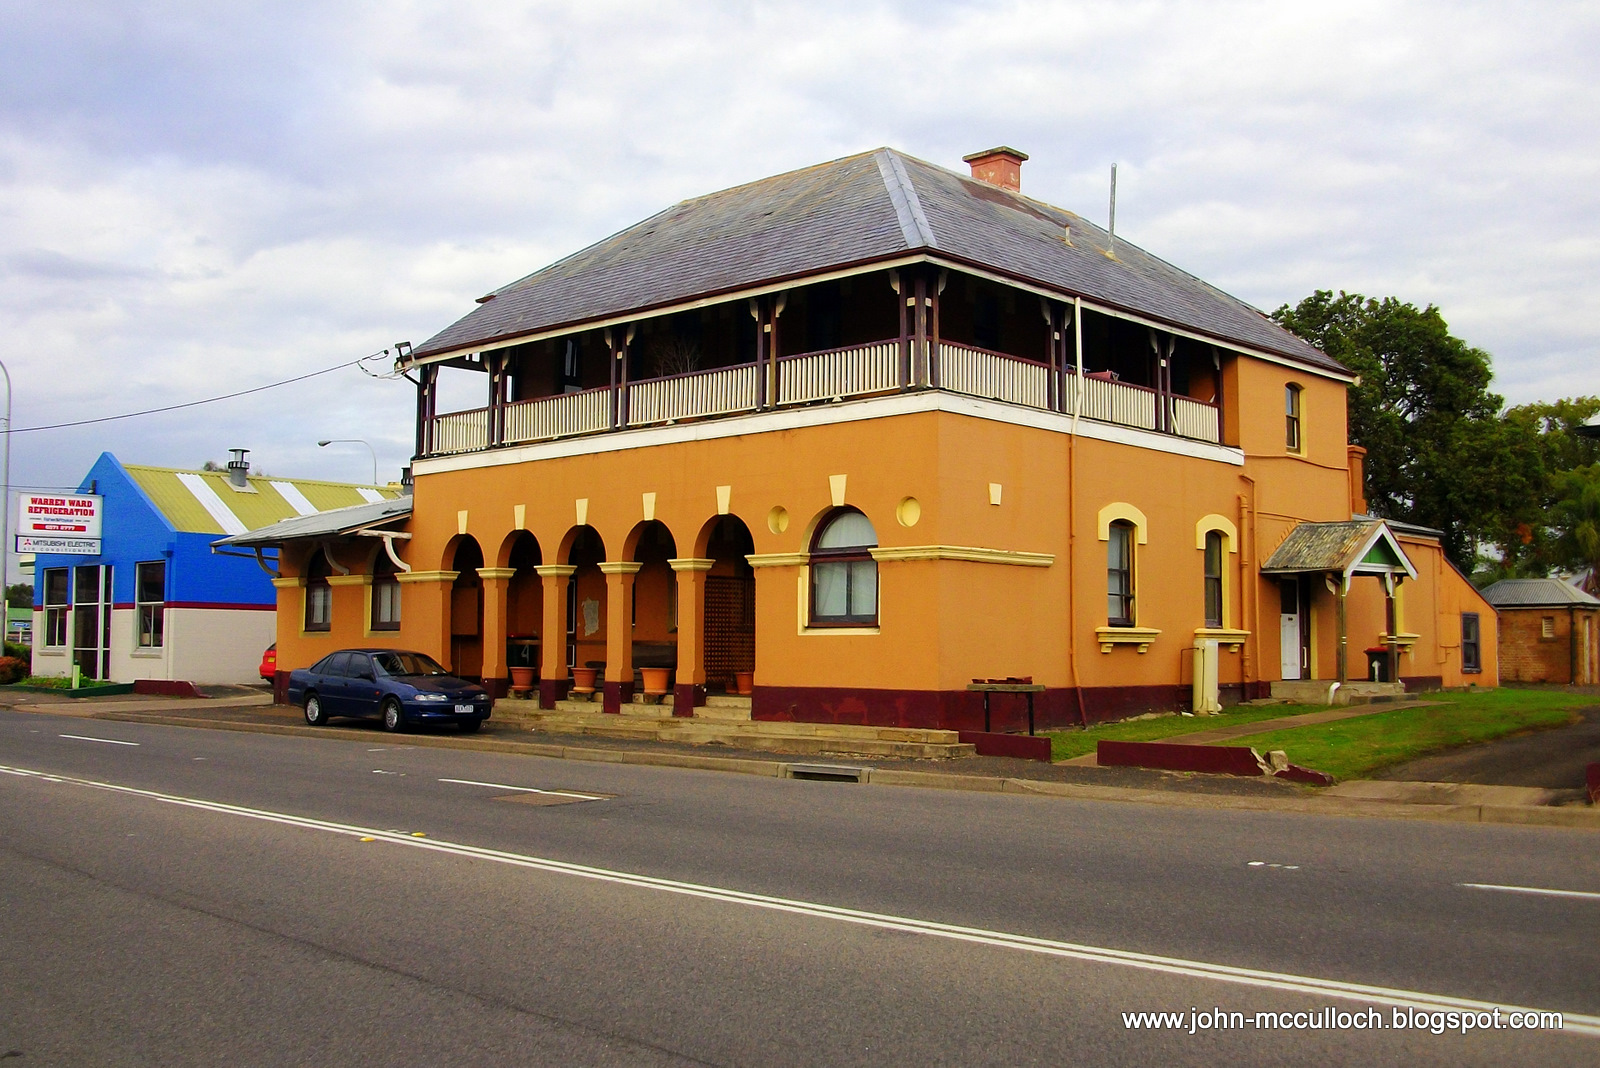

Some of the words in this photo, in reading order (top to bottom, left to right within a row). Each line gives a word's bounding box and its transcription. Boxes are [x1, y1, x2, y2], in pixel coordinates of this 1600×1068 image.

[30, 497, 66, 506] WARREN
[68, 499, 93, 508] WARD
[28, 506, 95, 516] REFRIGERATION
